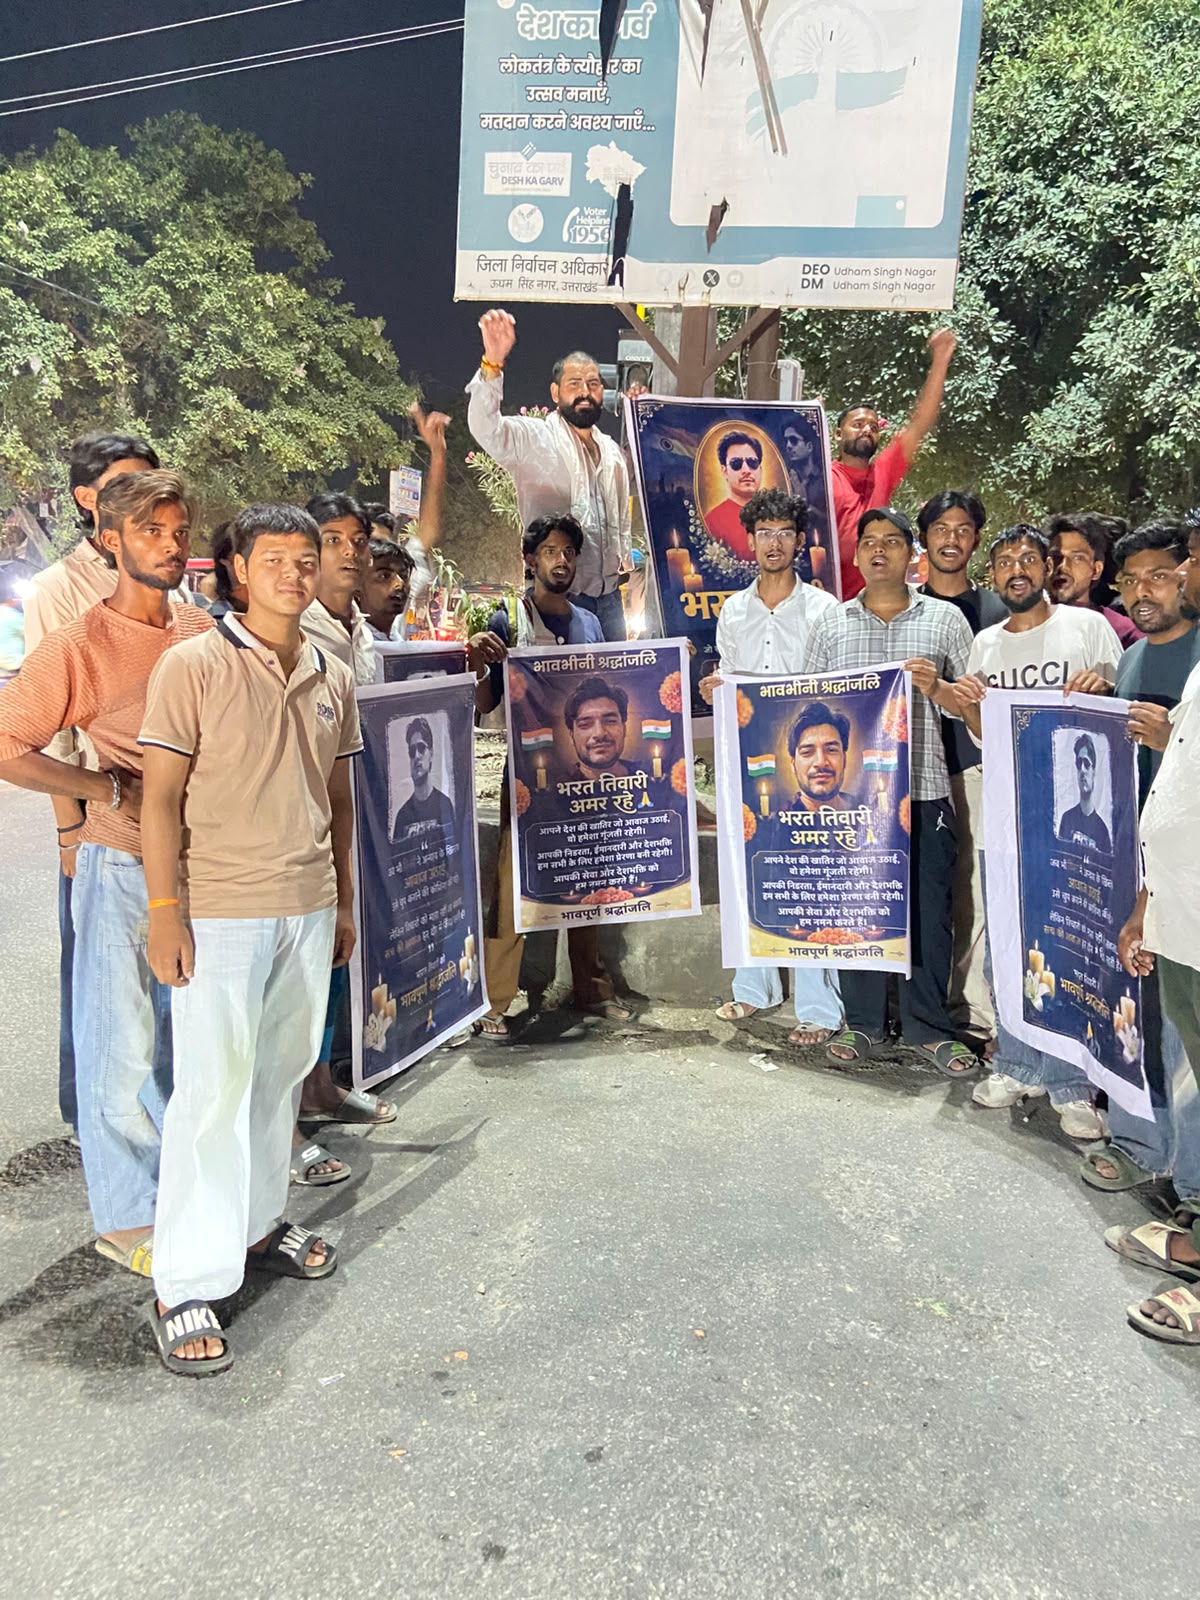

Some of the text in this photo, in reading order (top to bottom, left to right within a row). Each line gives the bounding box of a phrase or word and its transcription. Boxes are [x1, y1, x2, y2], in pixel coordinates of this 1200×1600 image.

[517, 2, 657, 41] देश का र्व
[499, 54, 554, 74] लोकतंत्र
[556, 54, 572, 74] के
[622, 58, 642, 74] का
[526, 86, 564, 101] उत्सव
[480, 114, 530, 129] मतदान
[532, 110, 568, 130] करने
[570, 115, 612, 130] अवश्य
[488, 162, 523, 179] चुनाव
[501, 176, 523, 184] DESH
[539, 177, 564, 185] GARV
[584, 207, 607, 215] Voter
[477, 254, 608, 275] जिला निर्वाचन अधिकार
[802, 264, 936, 278] DEO Udham Singh Nagar
[518, 277, 534, 289] सिंह
[537, 281, 558, 290] नगर,
[561, 282, 598, 292] उत्तराखंड
[801, 278, 936, 292] DM Udham Singh Nagar
[680, 590, 737, 620] भर
[534, 650, 657, 672] भावभीनी श्रद्धांजलि
[986, 661, 1069, 689] GUCCI
[760, 673, 881, 697] भावभीनी श्रद्धांजलि
[557, 770, 648, 797] भरत तिवारी
[570, 793, 637, 814] अमर रहे
[778, 805, 873, 827] भरत तिवारी
[540, 825, 565, 835] आपने
[563, 824, 576, 834] देश
[577, 823, 587, 831] की
[590, 821, 612, 830] खातिर
[613, 819, 623, 828] जो
[625, 818, 648, 826] आवाज
[578, 831, 598, 842] हमेशा
[790, 826, 861, 851] अमर रहे
[537, 851, 562, 860] आपकी
[628, 841, 642, 850] और
[537, 862, 548, 871] हम
[551, 859, 566, 868] सभी
[578, 857, 593, 865] लिए
[595, 855, 614, 864] हमेशा
[764, 856, 783, 864] आपने
[785, 856, 797, 864] देश
[799, 856, 809, 864] की
[811, 856, 834, 864] खातिर
[836, 856, 846, 865] जो
[849, 856, 876, 864] आवाज
[554, 873, 580, 883] आपकी
[582, 871, 597, 880] सेवा
[600, 868, 614, 879] और
[648, 863, 658, 871] को
[800, 867, 821, 875] हमेशा
[575, 881, 586, 890] हम
[588, 879, 607, 887] नमन
[609, 877, 626, 885] करते
[762, 881, 785, 889] आपकी
[855, 881, 870, 890] और
[774, 892, 790, 900] सभी
[792, 892, 799, 900] के
[801, 893, 816, 901] लिए
[818, 893, 839, 901] हमेशा
[561, 901, 651, 921] भावपूर्ण श्रद्धांजलि
[778, 907, 804, 916] आपकी
[806, 907, 822, 916] सेवा
[824, 907, 840, 916] और
[878, 907, 890, 916] को
[799, 918, 811, 926] हम
[834, 918, 854, 926] करते
[789, 946, 884, 959] भावपूर्ण श्रद्धांजलि
[278, 1225, 314, 1258] NIK
